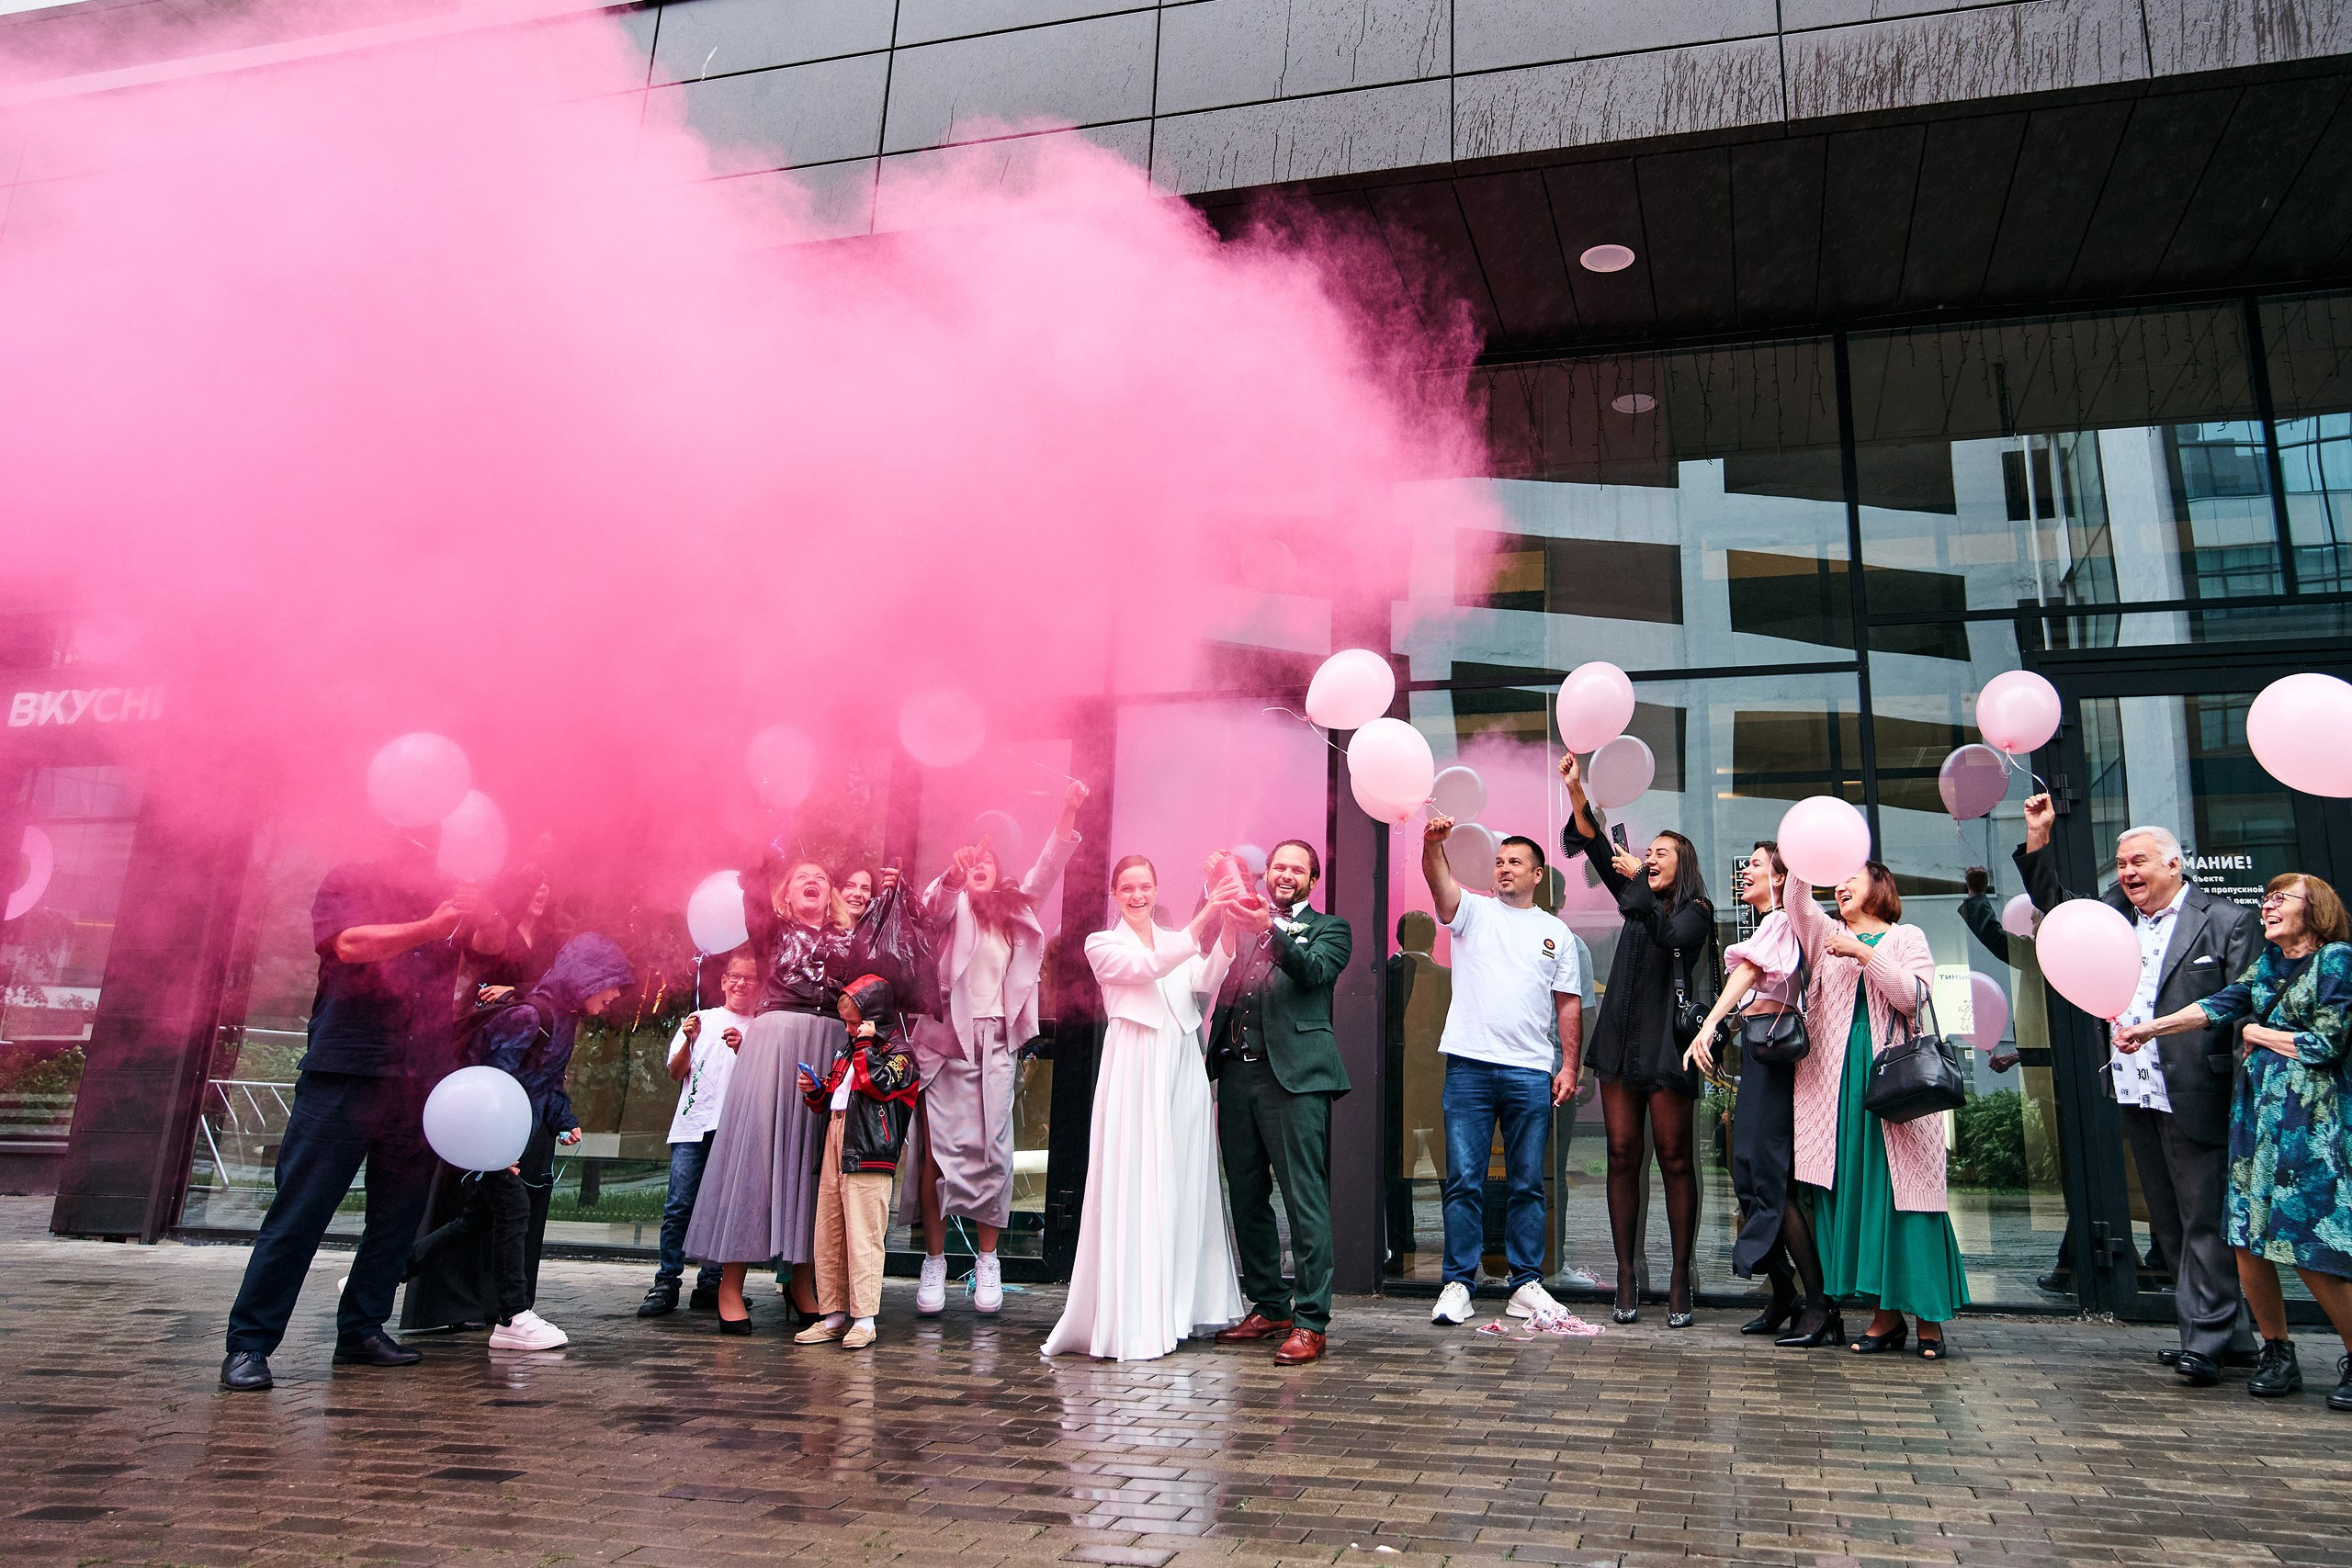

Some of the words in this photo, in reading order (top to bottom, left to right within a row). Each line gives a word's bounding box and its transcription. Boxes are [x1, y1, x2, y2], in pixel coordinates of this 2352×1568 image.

[2183, 855, 2253, 870] МАНИЕ!
[2211, 885, 2264, 895] пропускной
[1696, 1015, 1723, 1042] GSS
